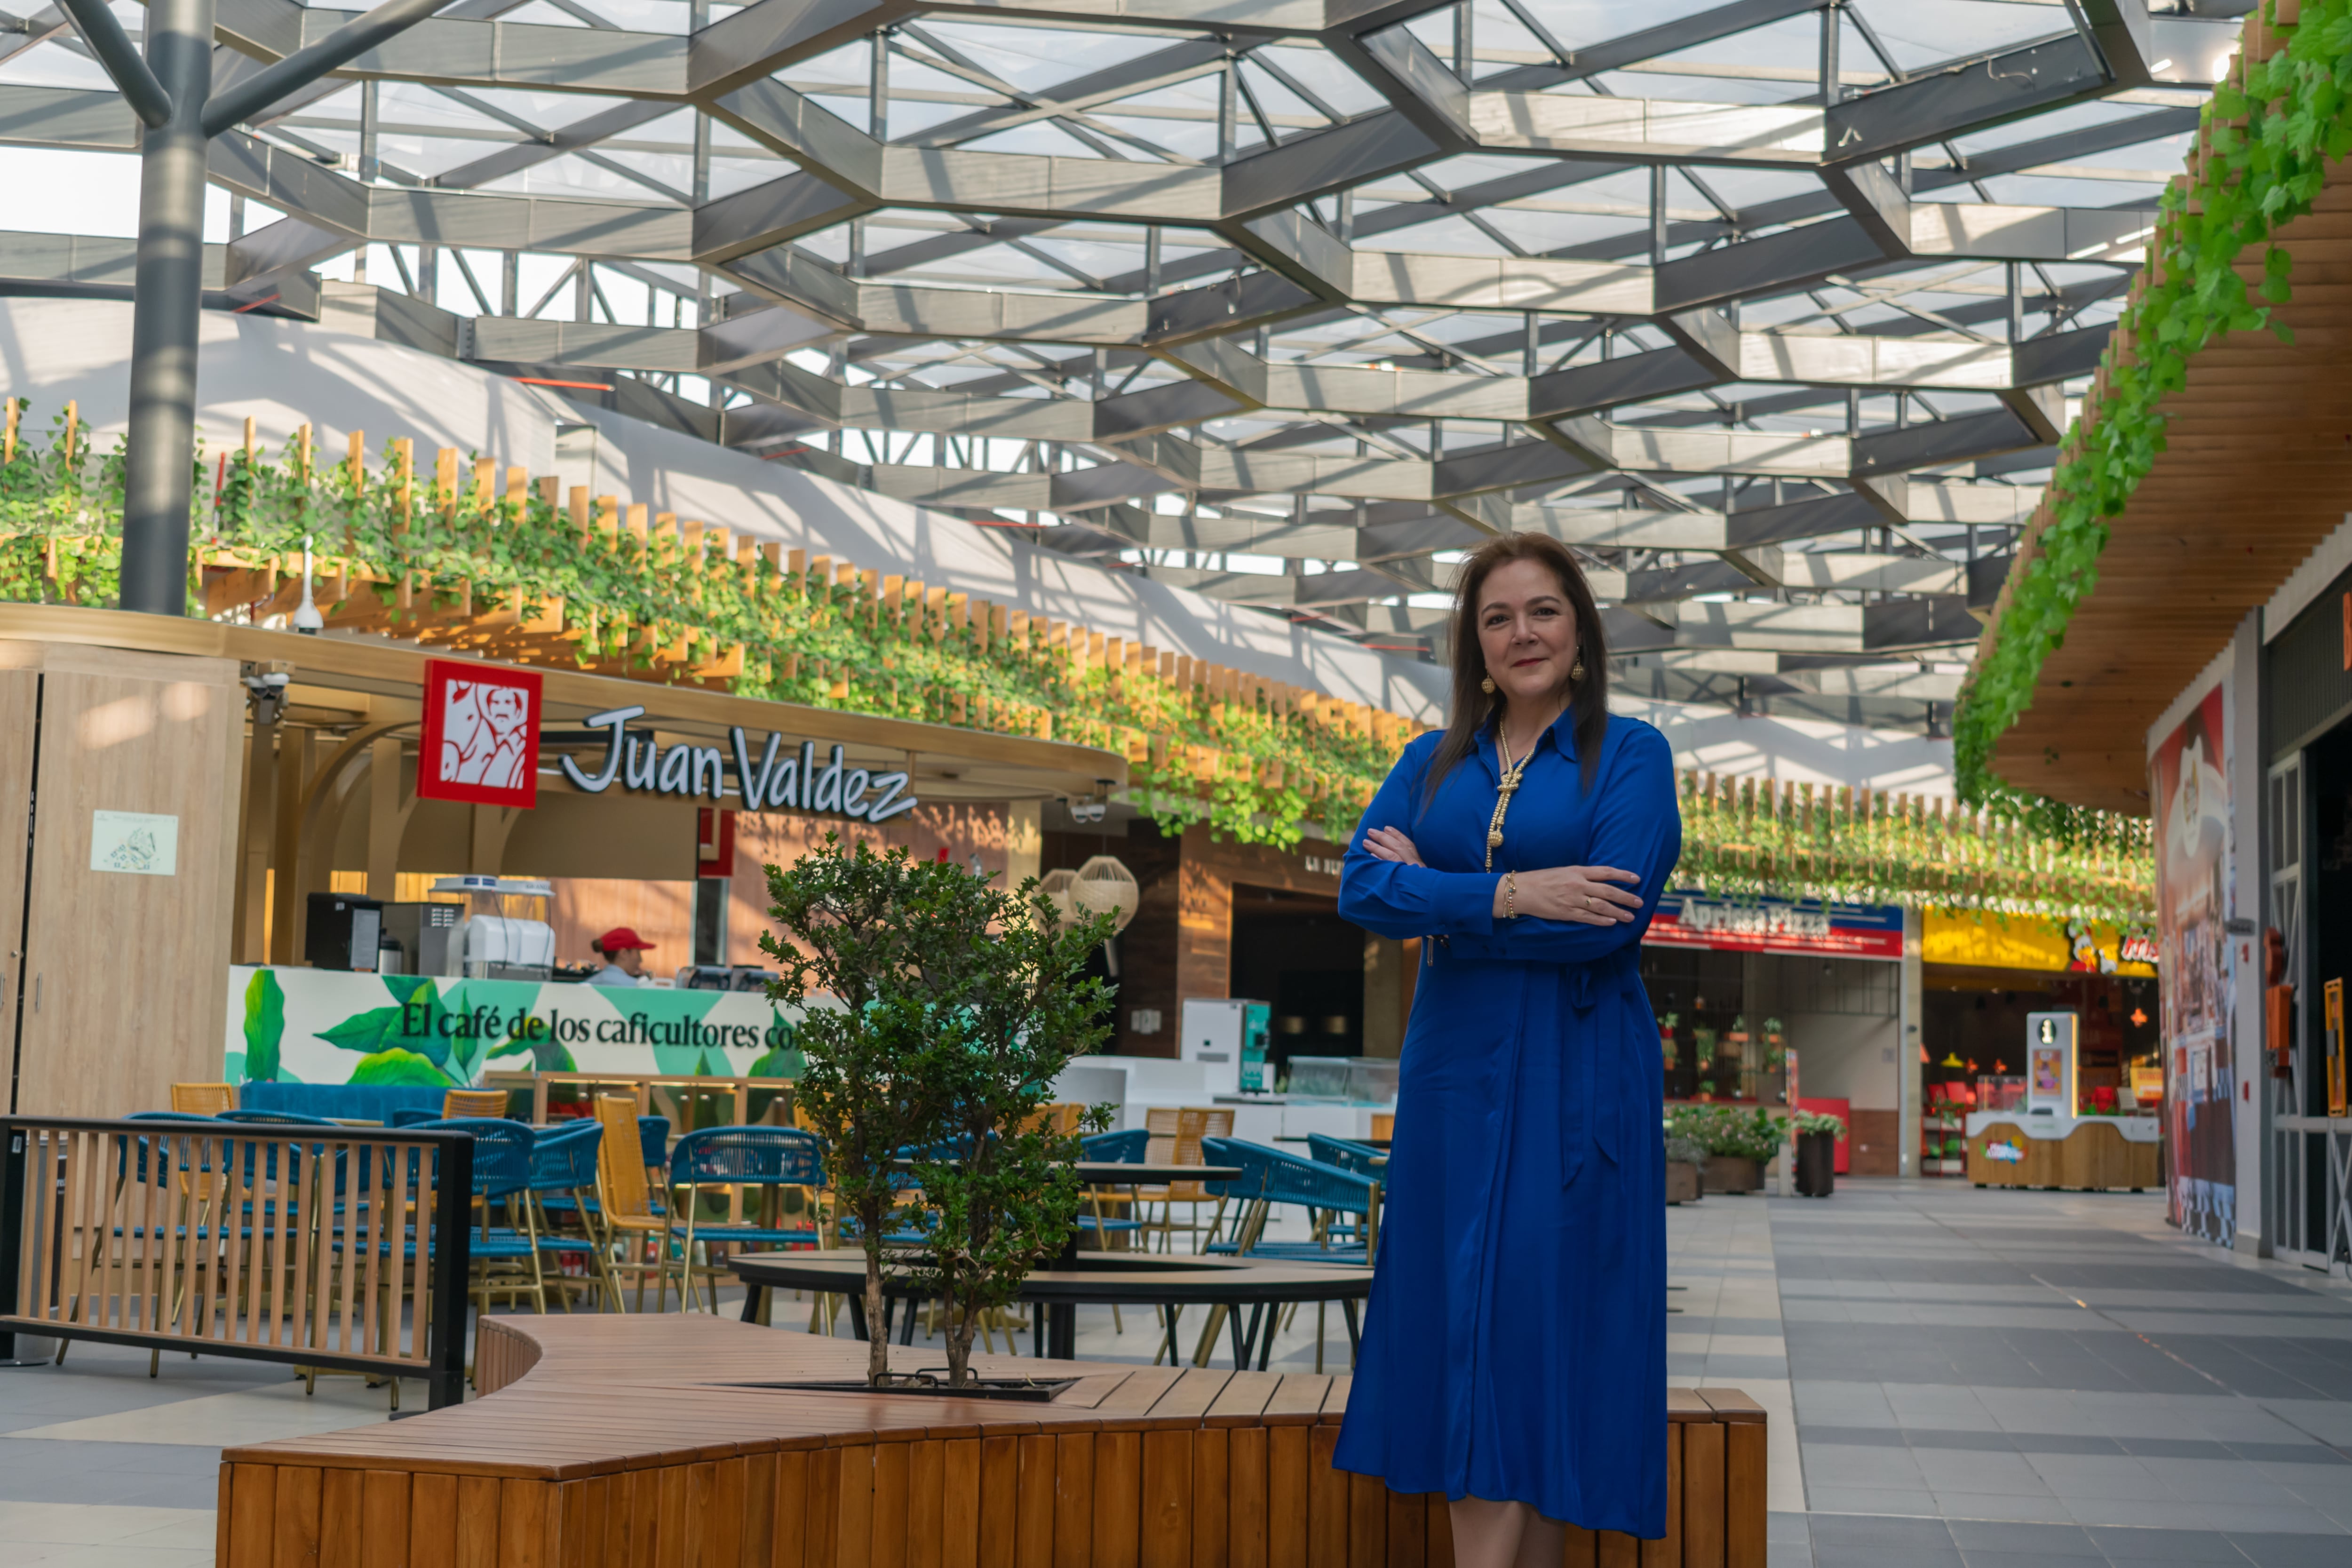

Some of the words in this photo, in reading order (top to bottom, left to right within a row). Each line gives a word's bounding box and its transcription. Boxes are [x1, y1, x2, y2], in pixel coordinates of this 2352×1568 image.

[558, 705, 723, 799] Juan
[730, 726, 918, 823] Valdez
[1767, 904, 1830, 935] Pizza
[402, 1002, 431, 1037] El
[437, 1005, 502, 1039] café
[507, 1007, 545, 1041] de
[550, 1009, 590, 1043] los
[596, 1011, 759, 1048] caficultores
